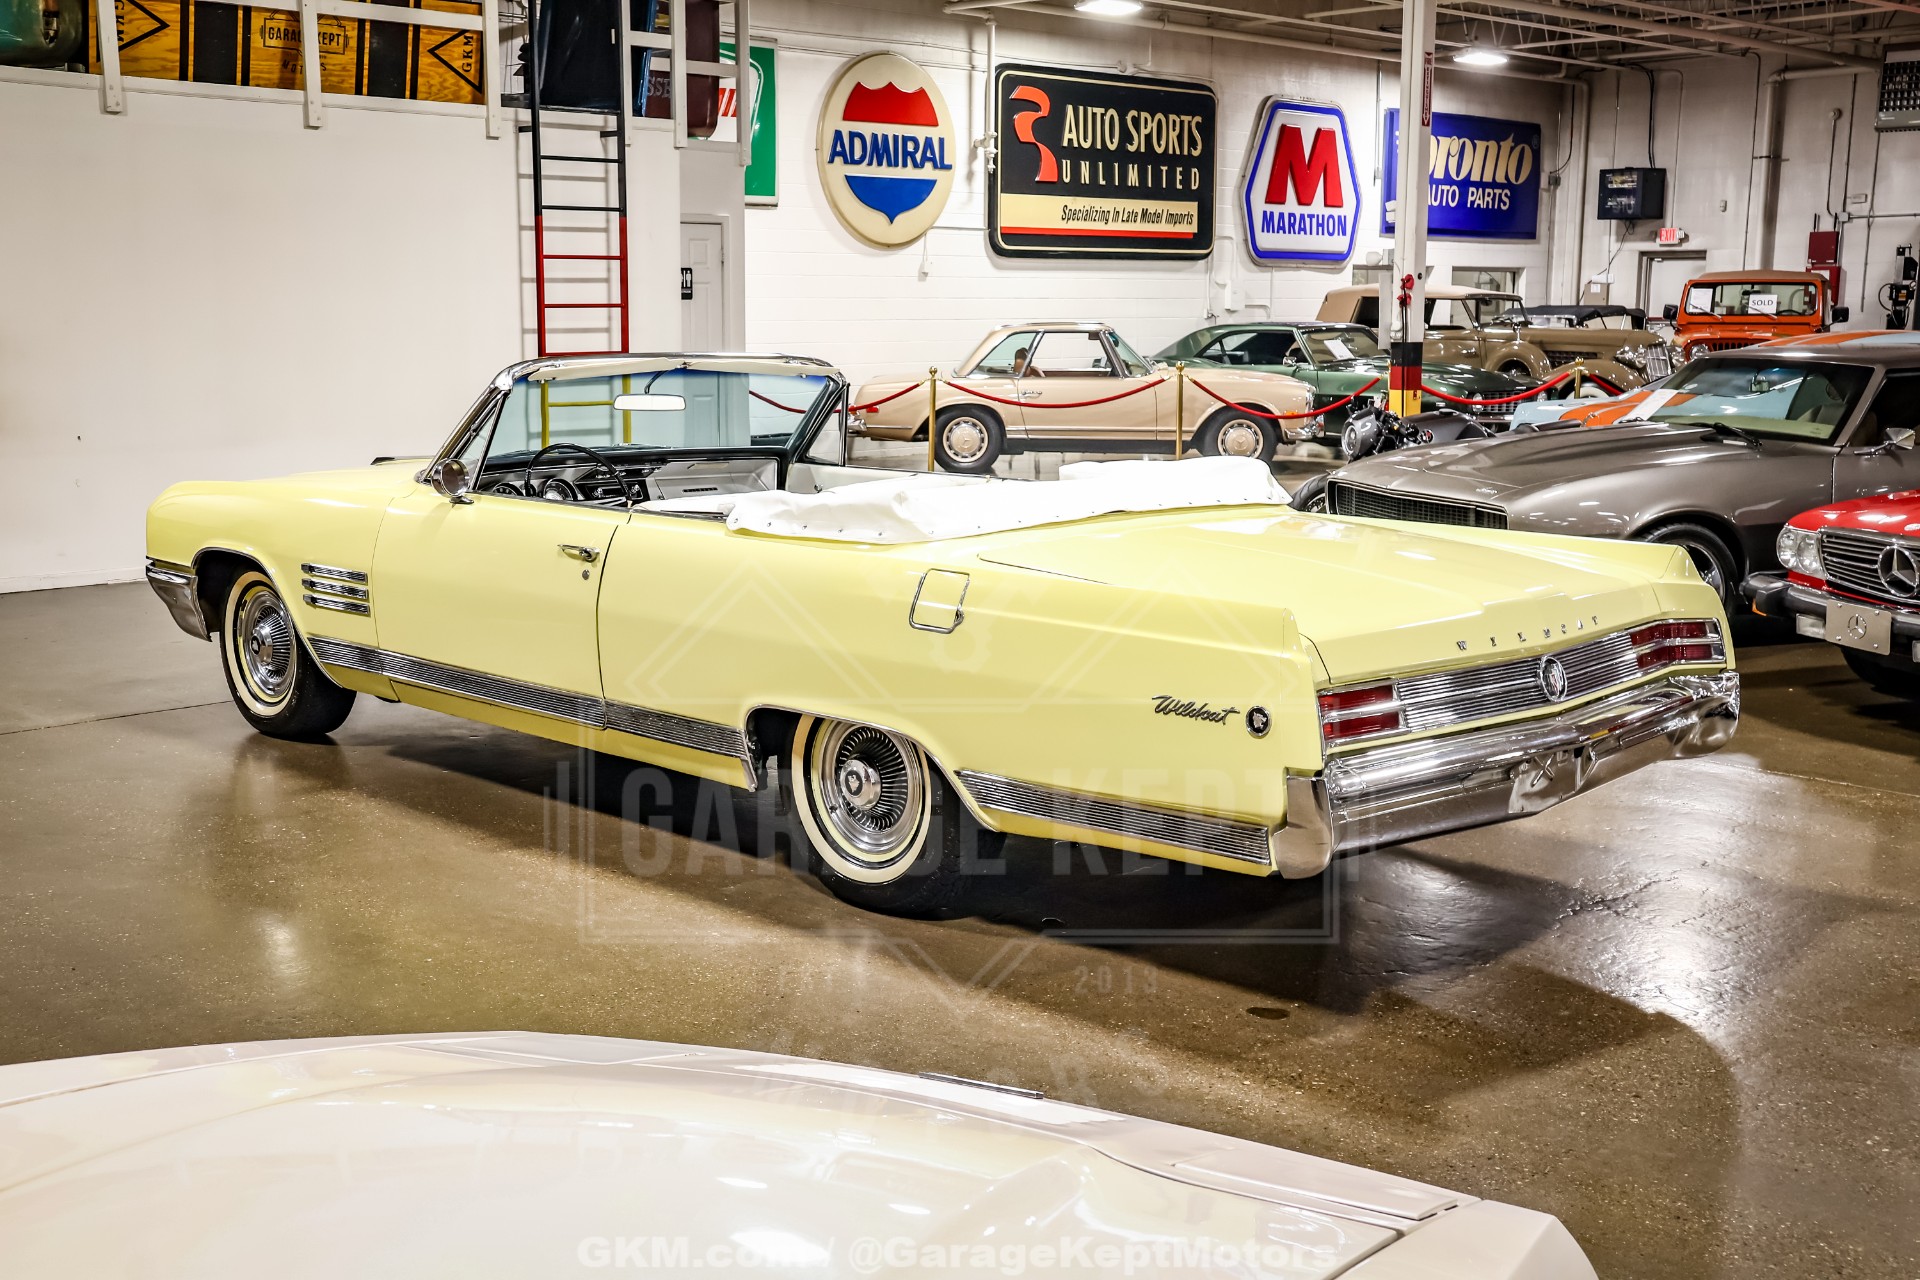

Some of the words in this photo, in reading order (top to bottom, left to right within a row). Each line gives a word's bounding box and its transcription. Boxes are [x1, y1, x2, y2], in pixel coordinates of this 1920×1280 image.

[268, 27, 303, 43] GARA
[462, 34, 474, 72] GKM
[282, 60, 327, 75] MOTS
[1062, 104, 1120, 150] AUTO
[1126, 110, 1202, 157] SPORTS
[828, 129, 953, 170] ADMIRAL
[1062, 159, 1200, 191] UNLIMITED
[1264, 123, 1344, 208] M
[1467, 187, 1511, 211] PARTS
[1061, 204, 1110, 225] Specializing
[1112, 206, 1120, 219] In
[1121, 207, 1138, 223] Late
[1139, 208, 1164, 225] Model
[1164, 209, 1194, 227] Imports
[1261, 210, 1347, 236] MARATHON
[1660, 228, 1677, 242] EXIT
[1151, 695, 1241, 725] Wildcat
